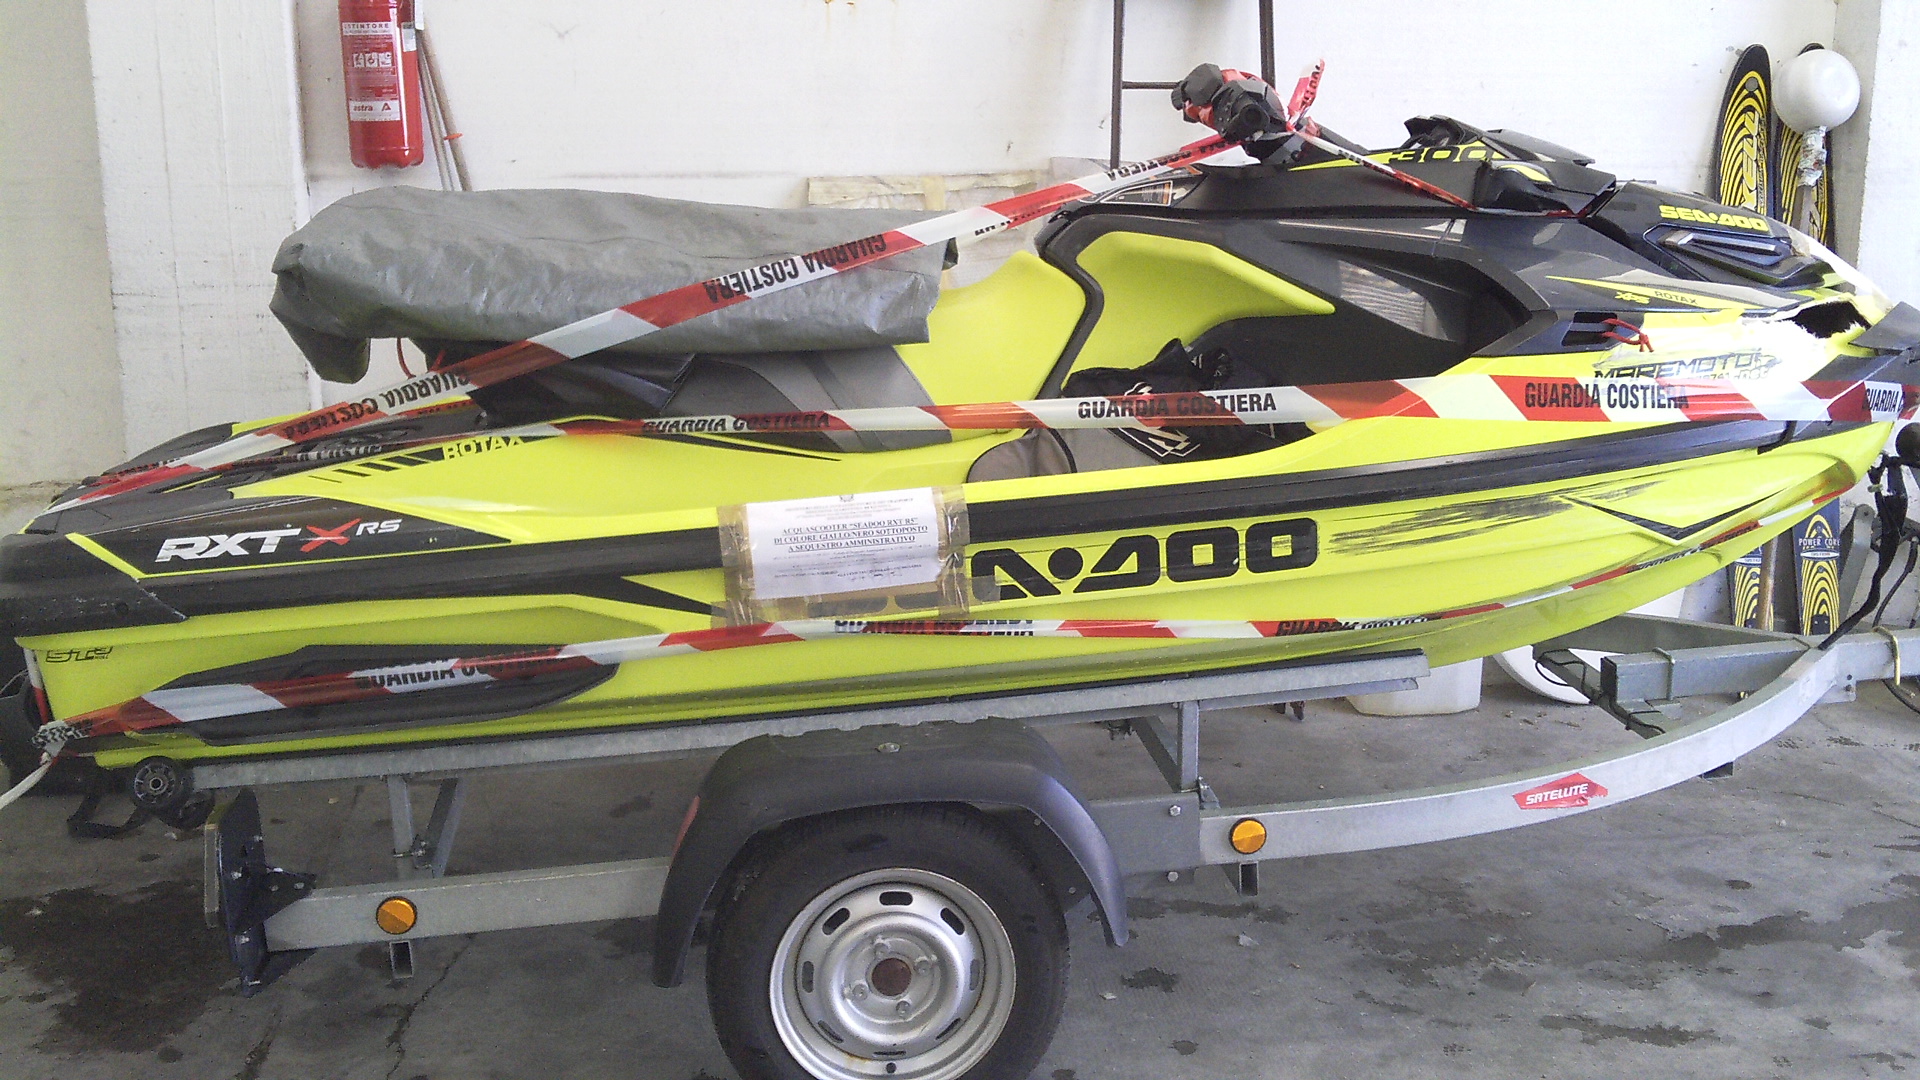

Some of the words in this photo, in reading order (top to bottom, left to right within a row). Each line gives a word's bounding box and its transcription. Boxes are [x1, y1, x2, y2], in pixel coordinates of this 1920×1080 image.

[801, 233, 887, 273] GUARDIA
[703, 258, 800, 303] COSTIERA
[1655, 291, 1698, 305] ROTAX
[1078, 401, 1170, 419] GUARDIA
[1177, 393, 1277, 416] COSTIERA
[1525, 382, 1602, 408] GUARDIA
[1607, 383, 1690, 409] COSTIERA
[643, 418, 727, 433] GUARDIA
[733, 413, 830, 431] COSTIERA
[444, 435, 527, 460] ROTAX
[155, 528, 302, 563] RXT
[356, 519, 402, 536] RS
[784, 533, 817, 544] COLORE
[876, 525, 928, 536] SOTTOPOSTO
[796, 541, 843, 551] SEQUESTRO
[845, 535, 916, 547] AMMINISTRATIVO
[1798, 538, 1821, 546] POWER
[1525, 783, 1588, 805] SATELLITE
